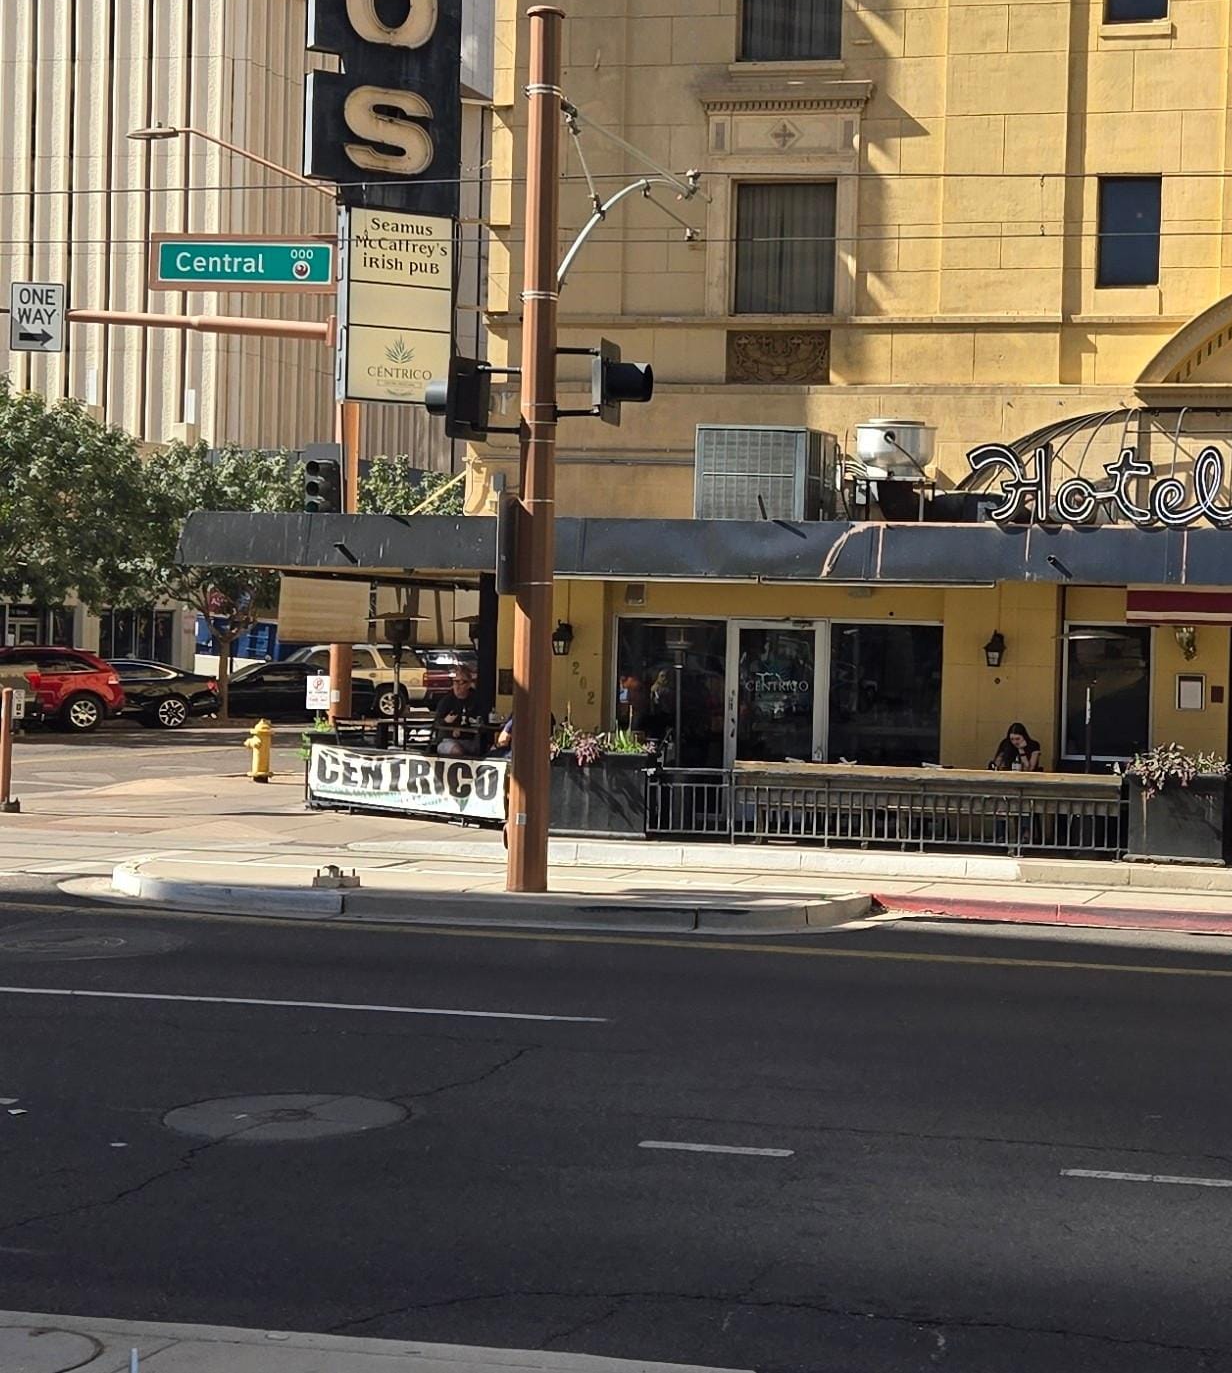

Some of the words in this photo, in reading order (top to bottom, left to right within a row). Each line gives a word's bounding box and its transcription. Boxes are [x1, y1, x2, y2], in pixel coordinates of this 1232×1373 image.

[370, 217, 434, 237] Seamus
[355, 234, 449, 259] McCaffrey's
[175, 251, 265, 274] Central
[290, 249, 314, 260] 000
[19, 287, 56, 306] ONE
[17, 307, 57, 325] WAY
[317, 748, 500, 801] CENTRICO
